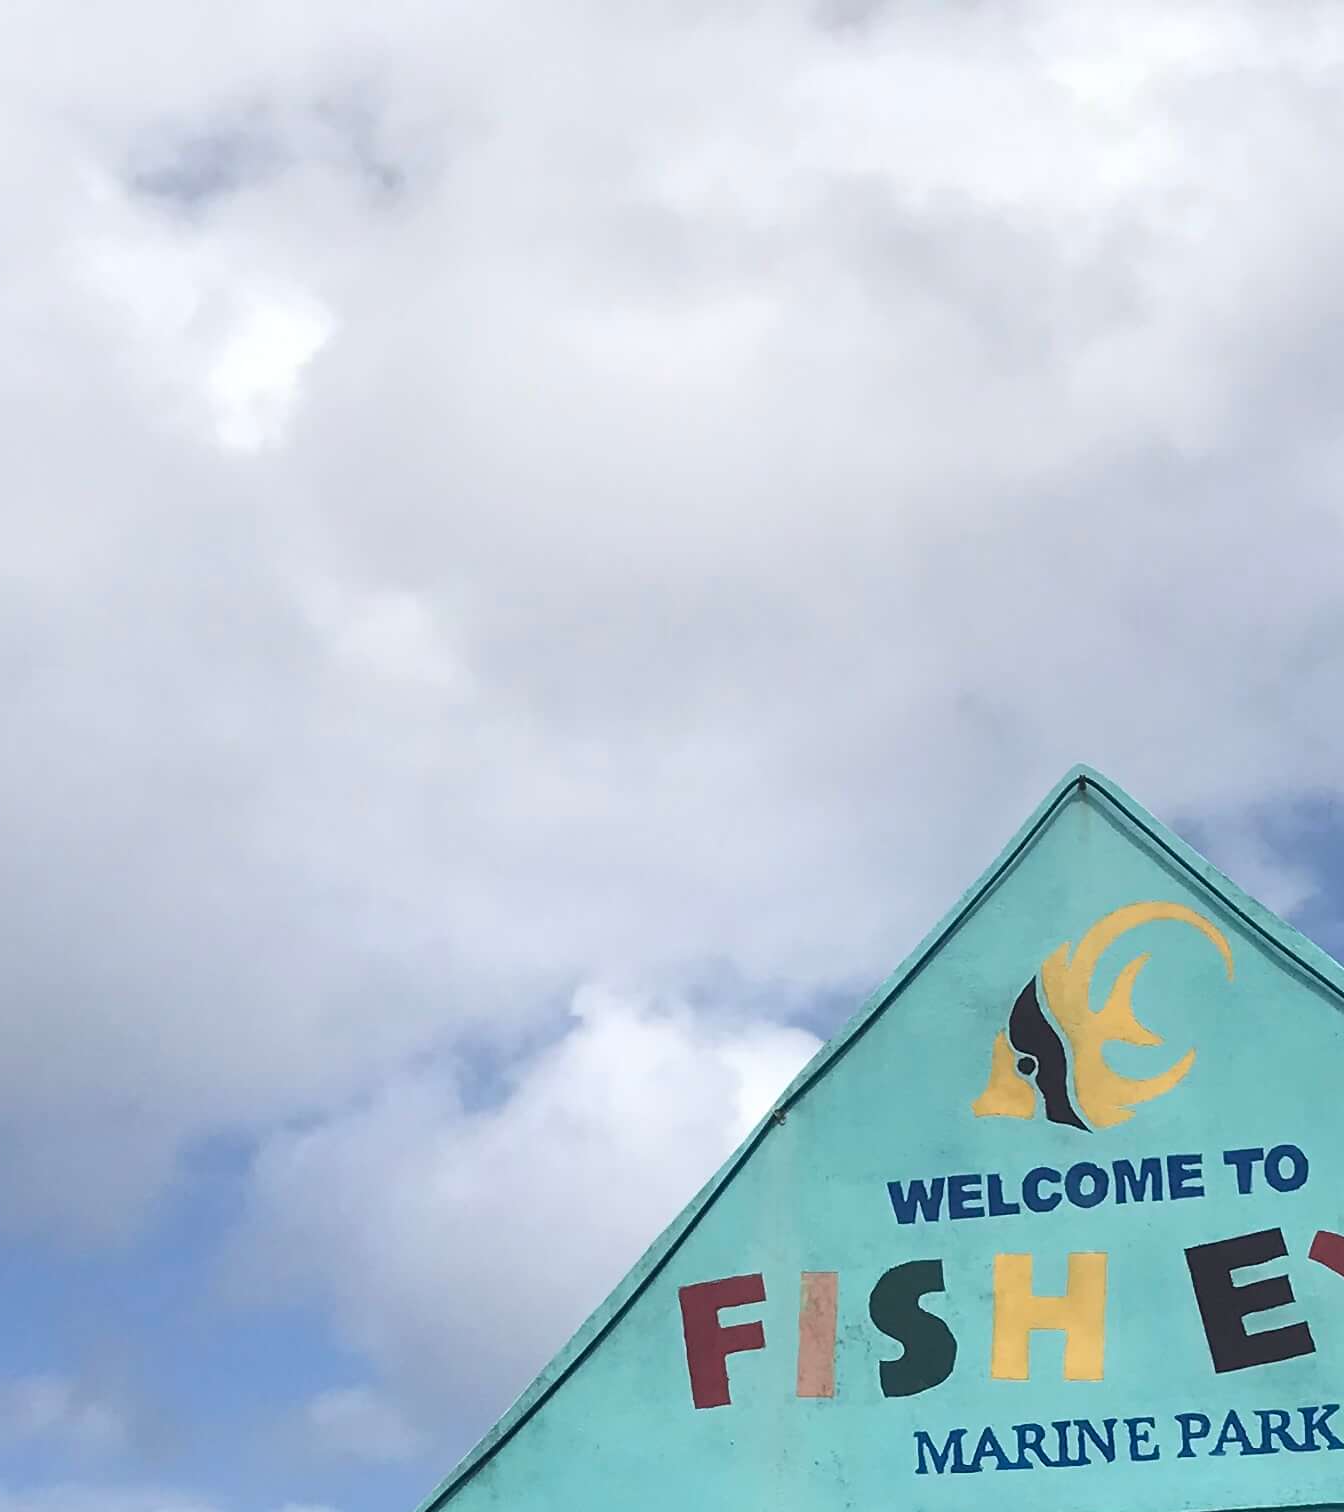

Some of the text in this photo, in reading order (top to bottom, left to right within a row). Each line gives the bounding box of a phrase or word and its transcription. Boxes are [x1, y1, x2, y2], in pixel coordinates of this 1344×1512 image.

[887, 1144, 1310, 1225] WELCOME TO
[678, 1251, 1108, 1410] FISH
[913, 1417, 1158, 1475] MARINE
